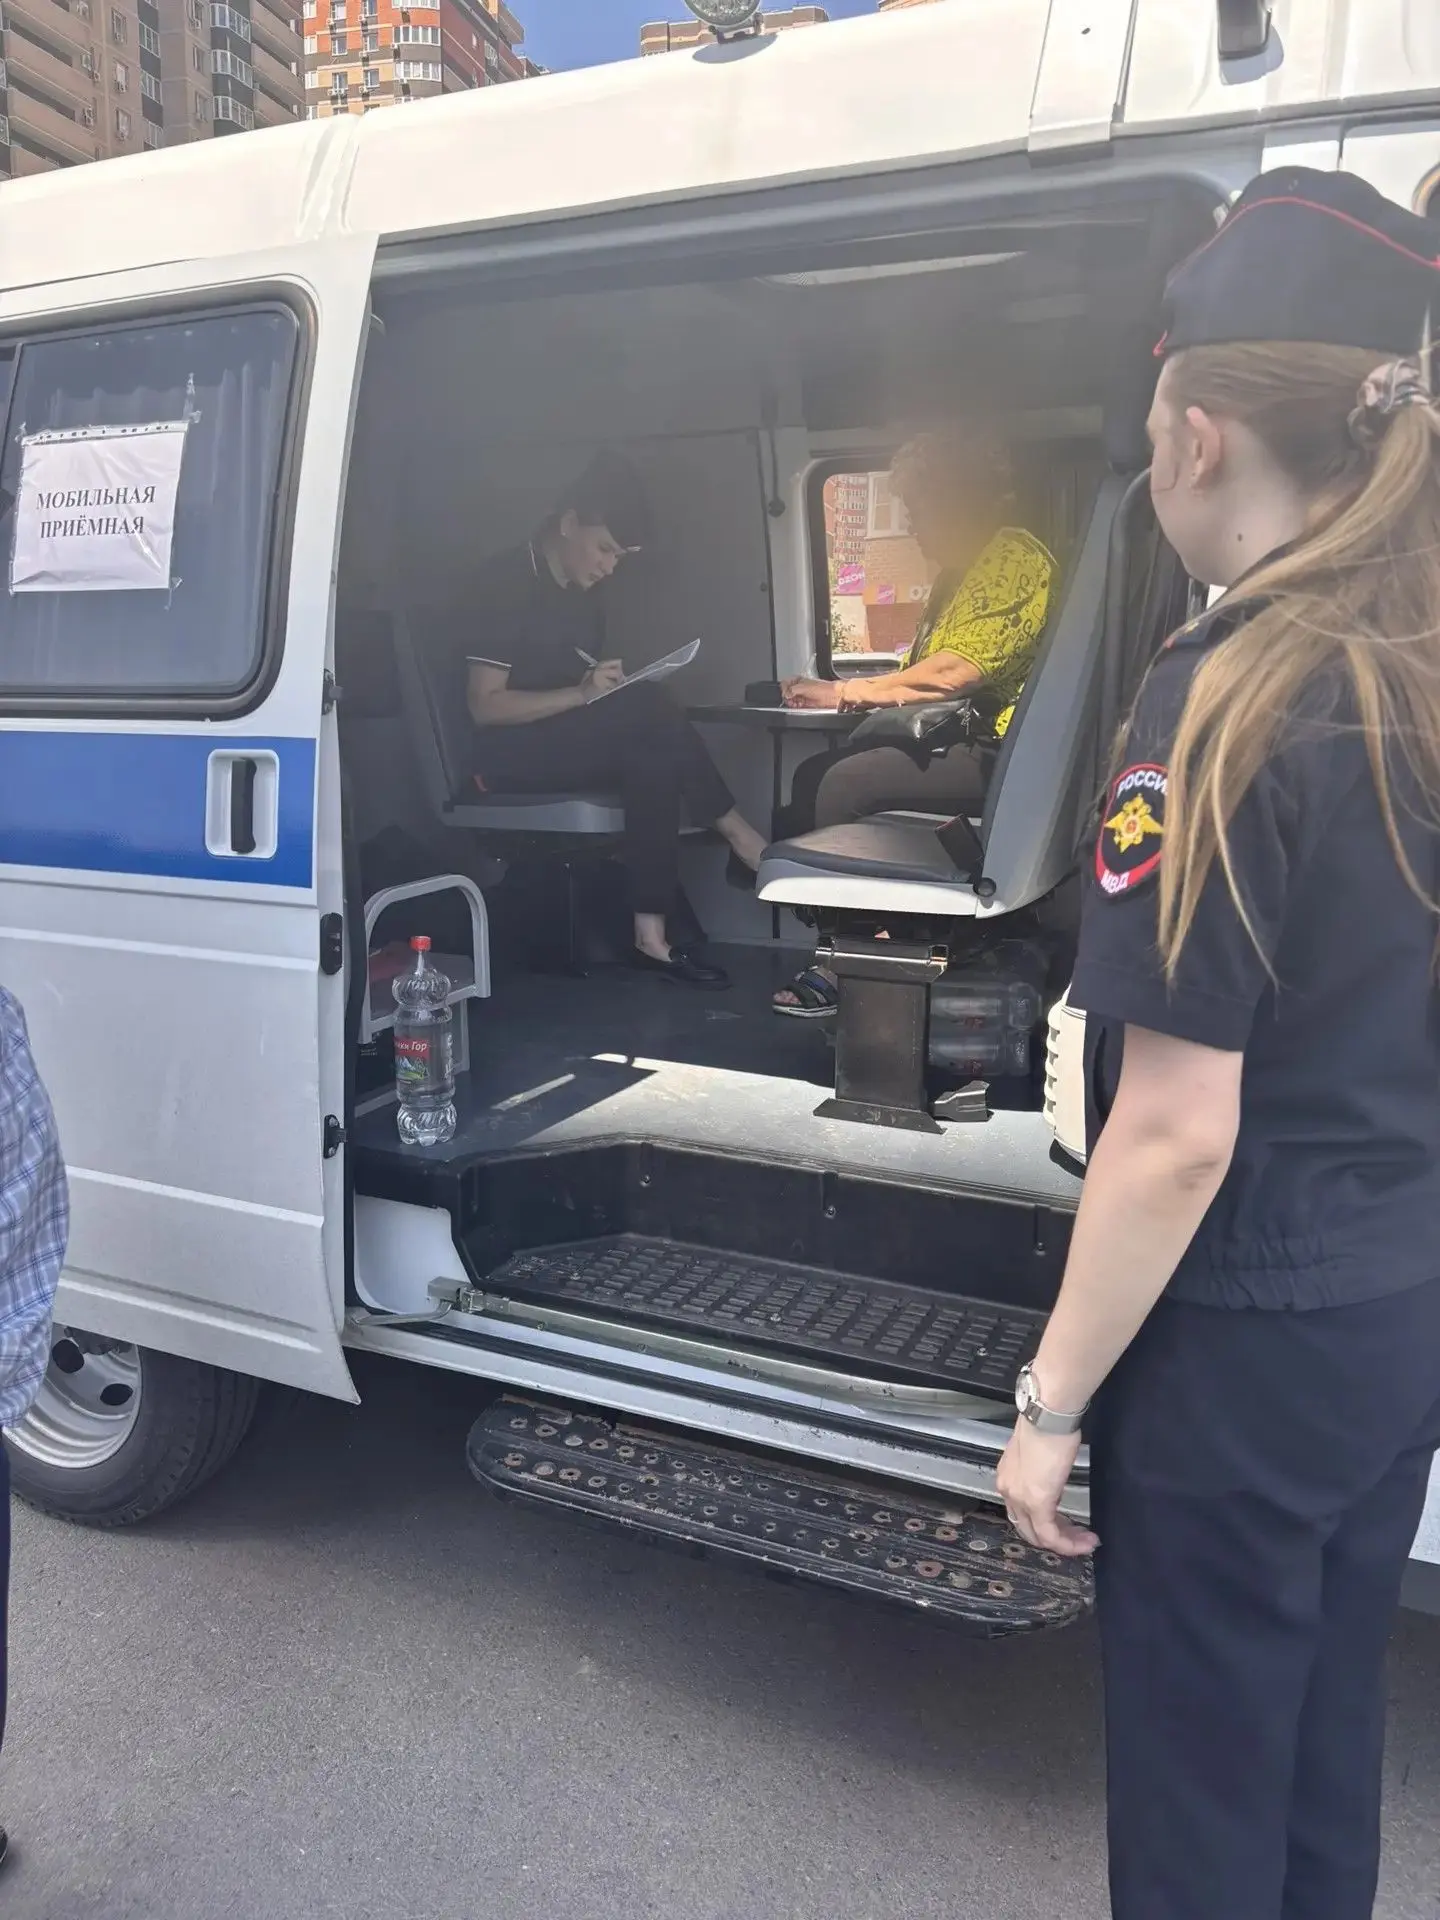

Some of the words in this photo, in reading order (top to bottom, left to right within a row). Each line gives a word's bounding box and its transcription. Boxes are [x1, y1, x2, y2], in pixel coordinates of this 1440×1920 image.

[36, 486, 156, 510] МОБИЛЬНАЯ
[40, 515, 144, 538] ПРИЁМНАЯ
[1100, 869, 1130, 894] МВД
[411, 1041, 427, 1052] Гор
